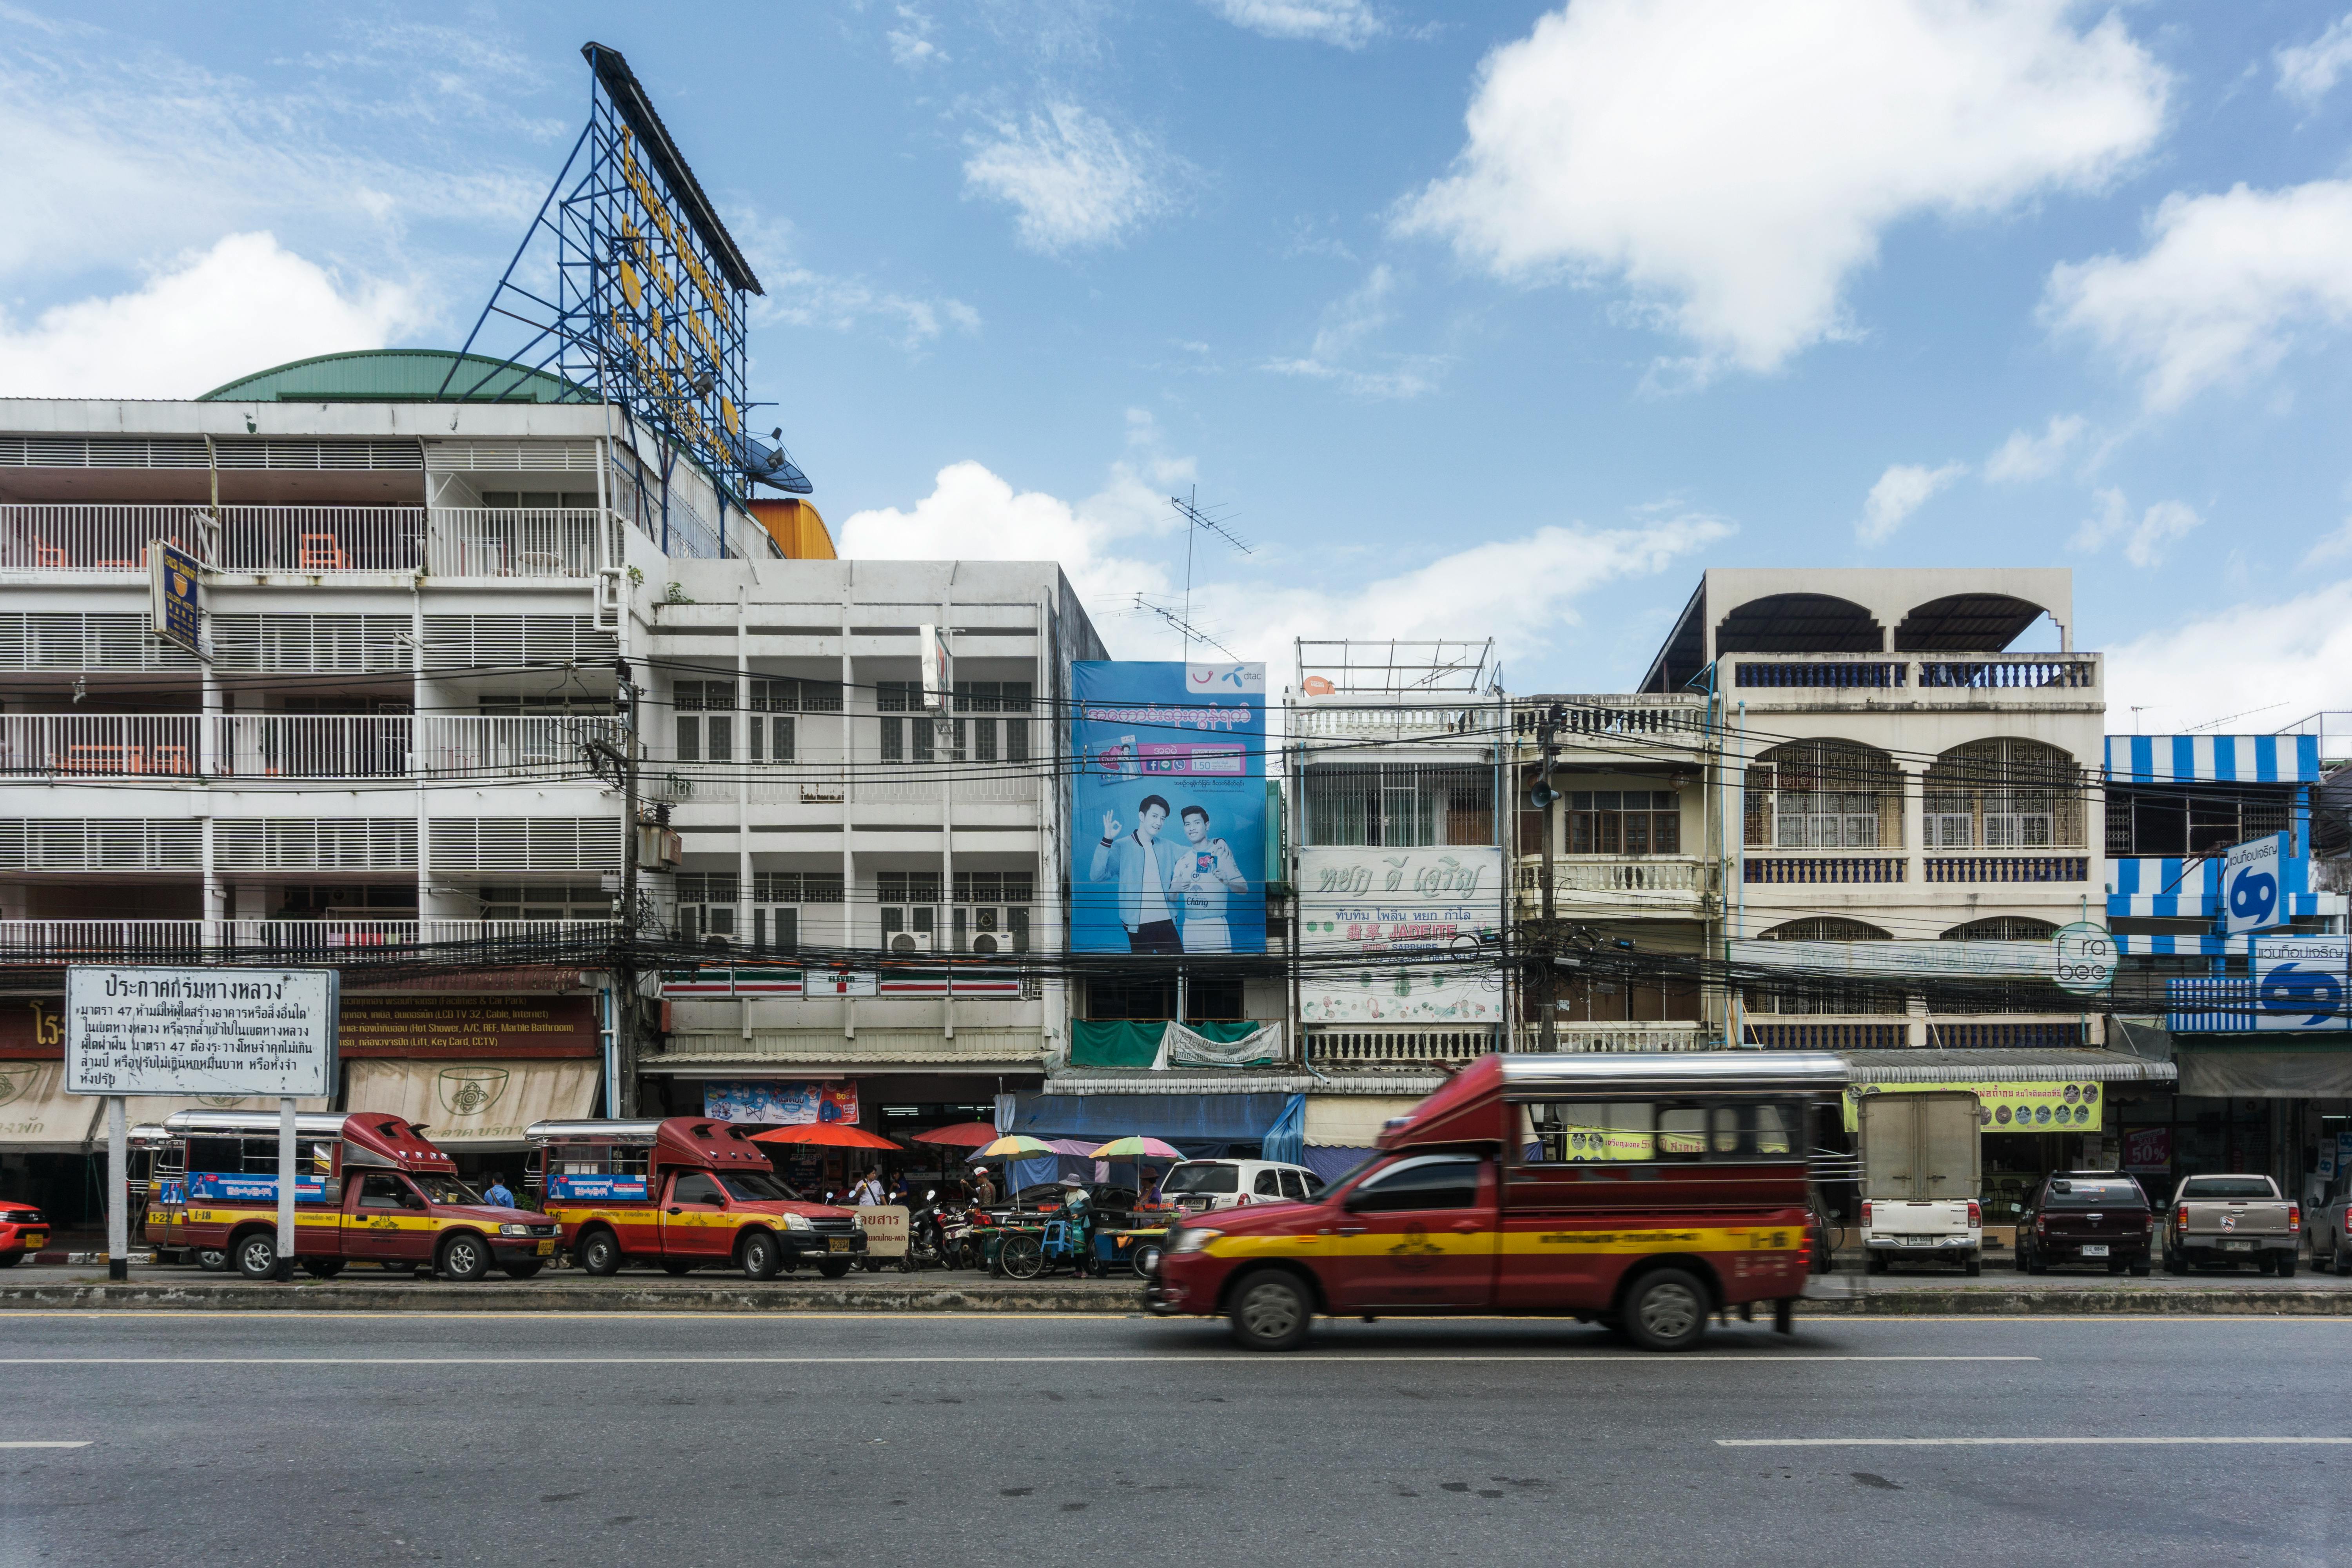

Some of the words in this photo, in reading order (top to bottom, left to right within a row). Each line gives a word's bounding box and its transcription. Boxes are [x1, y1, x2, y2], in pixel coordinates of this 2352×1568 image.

[622, 213, 675, 305] GOLDEN
[688, 305, 722, 372] HOTEL
[1244, 668, 1261, 680] dtac
[2229, 845, 2277, 866] แว่นท็อปเจริญ
[1187, 897, 1209, 907] Chang
[1336, 908, 1369, 920] ทับทิม
[1413, 911, 1437, 921] หยก
[1445, 906, 1471, 920] กำไล
[1388, 924, 1457, 940] JADEITE
[2259, 945, 2343, 958] แว่นท็อปเจริญ
[2058, 958, 2106, 980] bee
[106, 974, 282, 1000] ประกาศกรมทางหลวง
[505, 997, 526, 1005] Park)
[81, 1005, 113, 1016] มาตรา
[118, 1007, 132, 1016] 47
[435, 1010, 454, 1019] (LCD
[486, 1010, 510, 1019] Cable,
[513, 1010, 549, 1019] Internet)
[83, 1017, 159, 1034] ในเขตทางหลวง
[410, 1024, 426, 1033] (Hot
[429, 1024, 461, 1033] Shower,
[463, 1024, 481, 1033] A/C,
[483, 1024, 499, 1033] REF,
[501, 1024, 530, 1032] Marble
[532, 1024, 574, 1032] Bathroom)
[132, 1041, 166, 1051] มาตรา
[170, 1042, 185, 1051] 47
[411, 1038, 430, 1047] (Lift,
[432, 1038, 446, 1047] Key
[449, 1037, 470, 1046] Card,
[472, 1037, 498, 1046] CCTV)
[2138, 1137, 2158, 1147] SALE
[2132, 1145, 2165, 1163] 50%
[194, 1210, 211, 1220] 1-18
